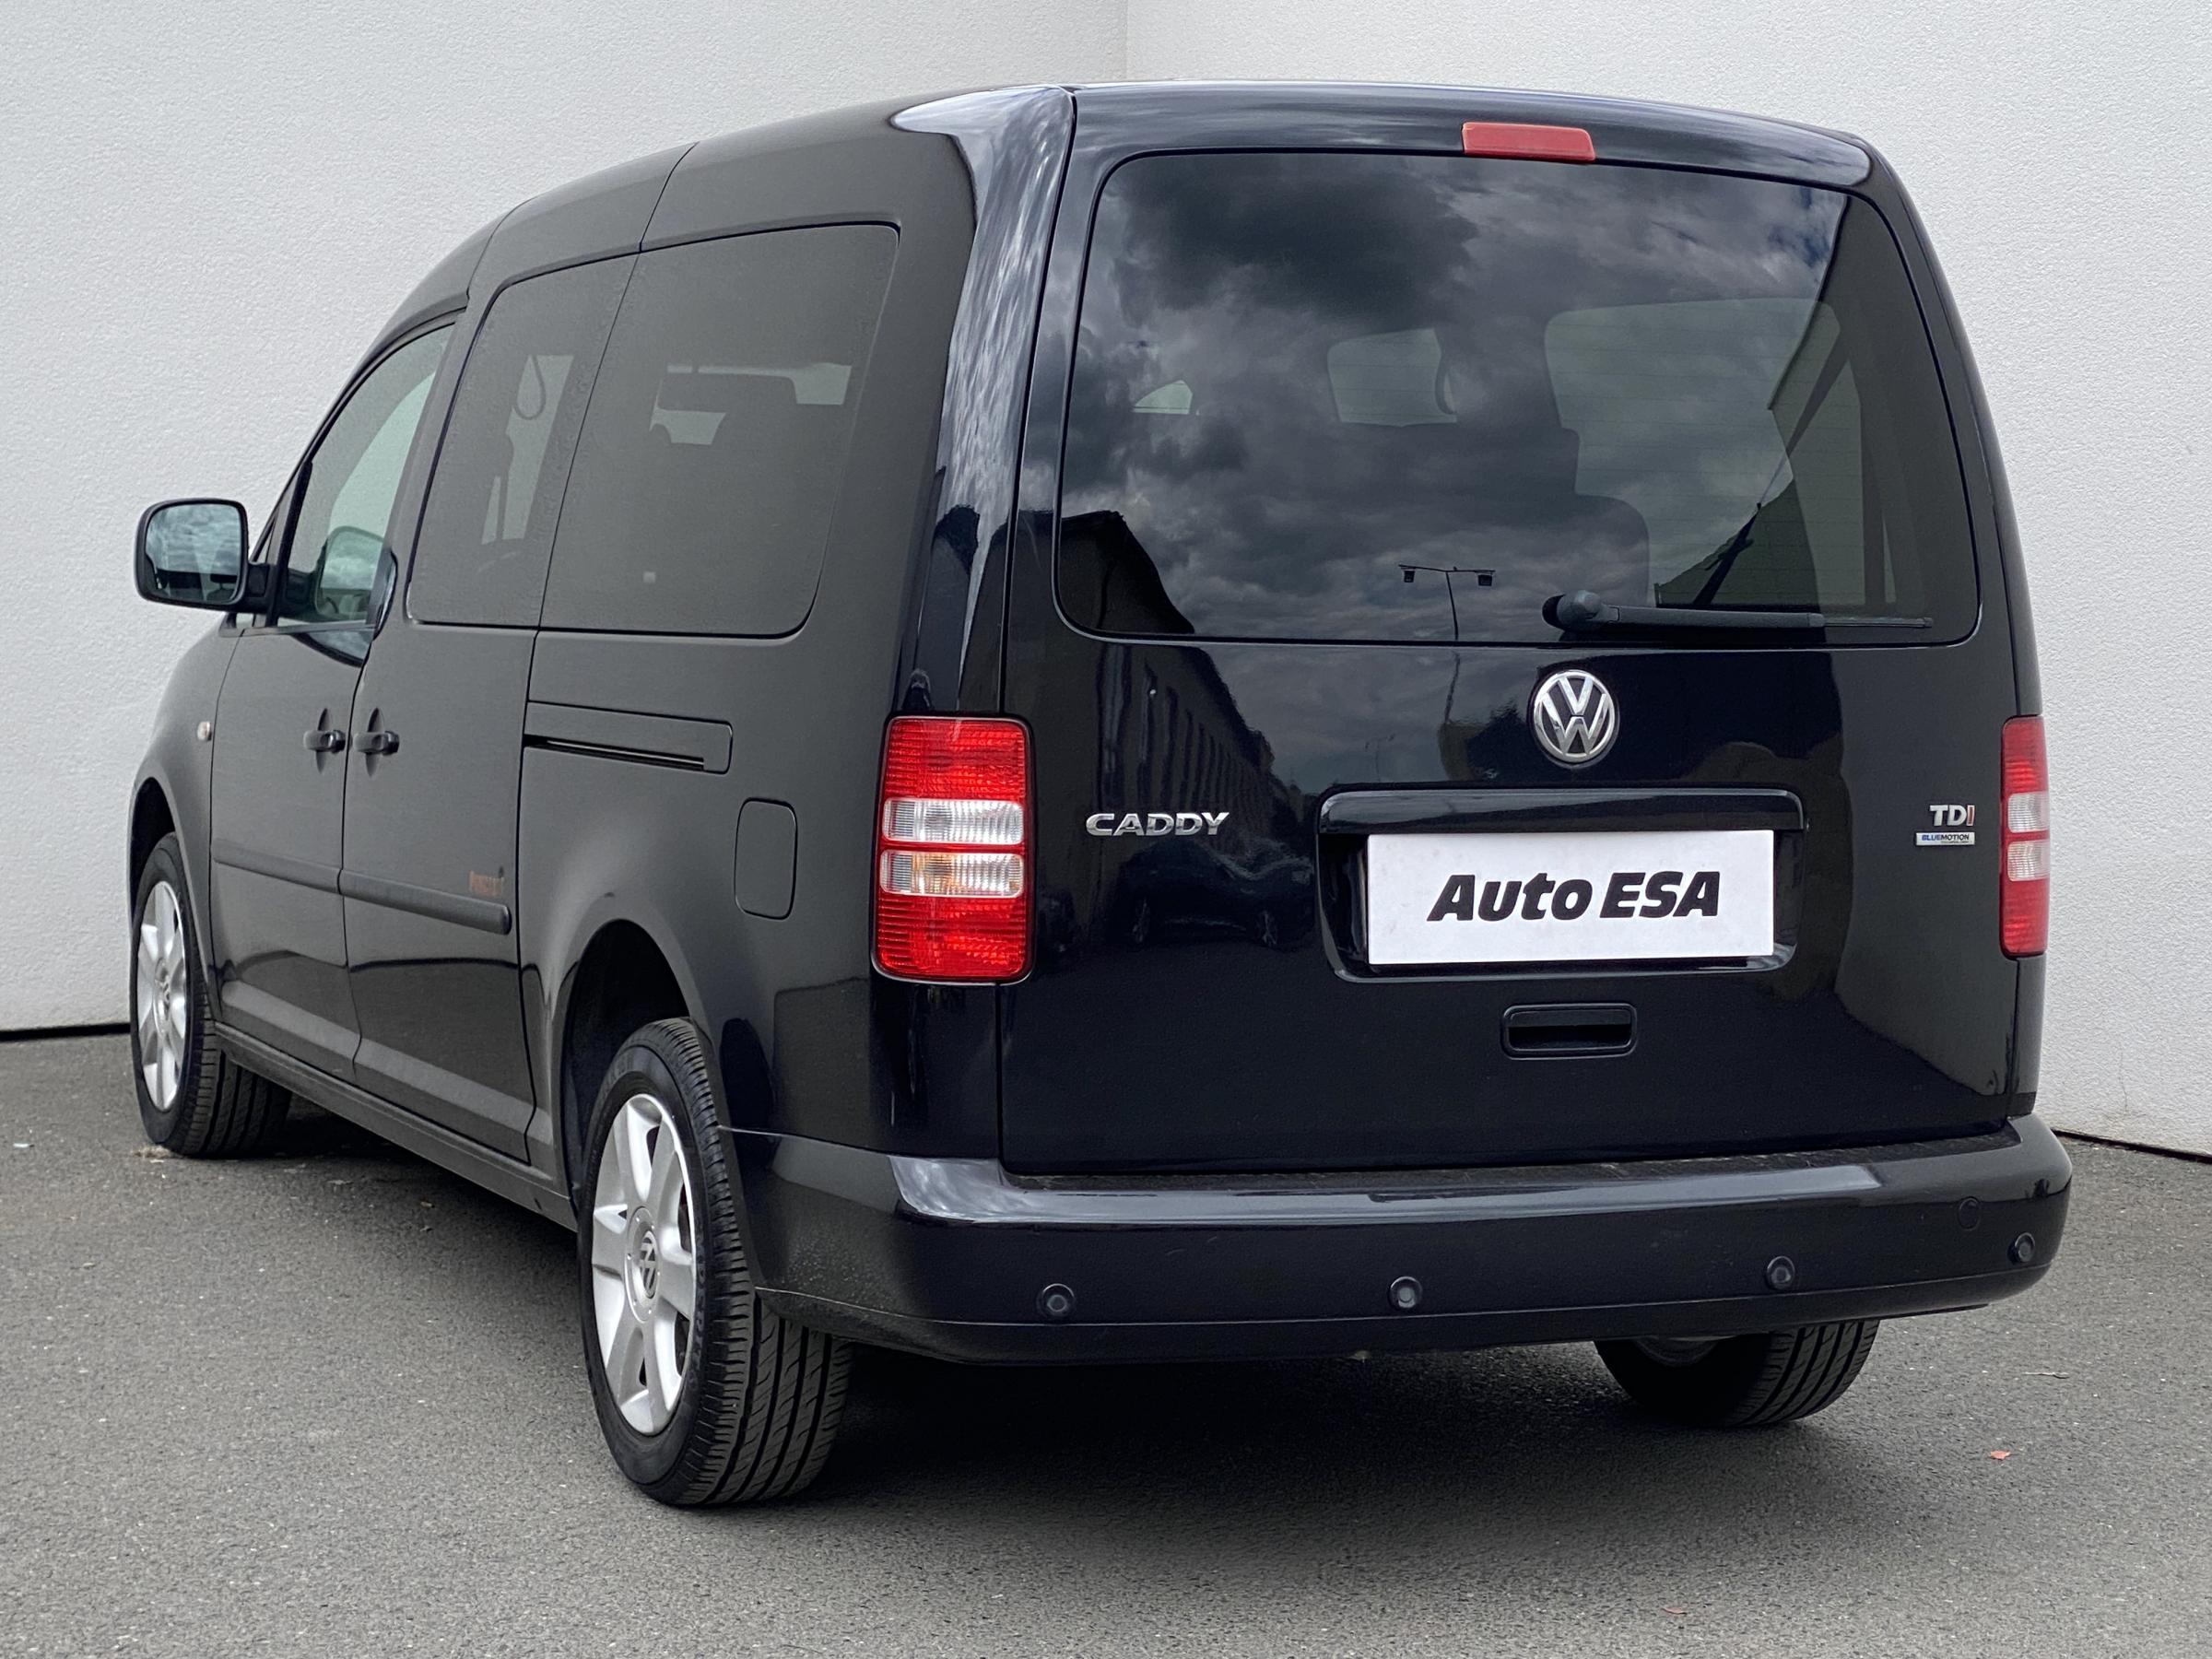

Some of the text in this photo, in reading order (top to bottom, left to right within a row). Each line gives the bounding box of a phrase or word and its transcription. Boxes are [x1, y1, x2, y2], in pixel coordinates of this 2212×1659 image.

[1086, 811, 1230, 836] CADDY
[1929, 804, 1975, 827] TDI
[1426, 871, 1721, 922] Auto ESA
